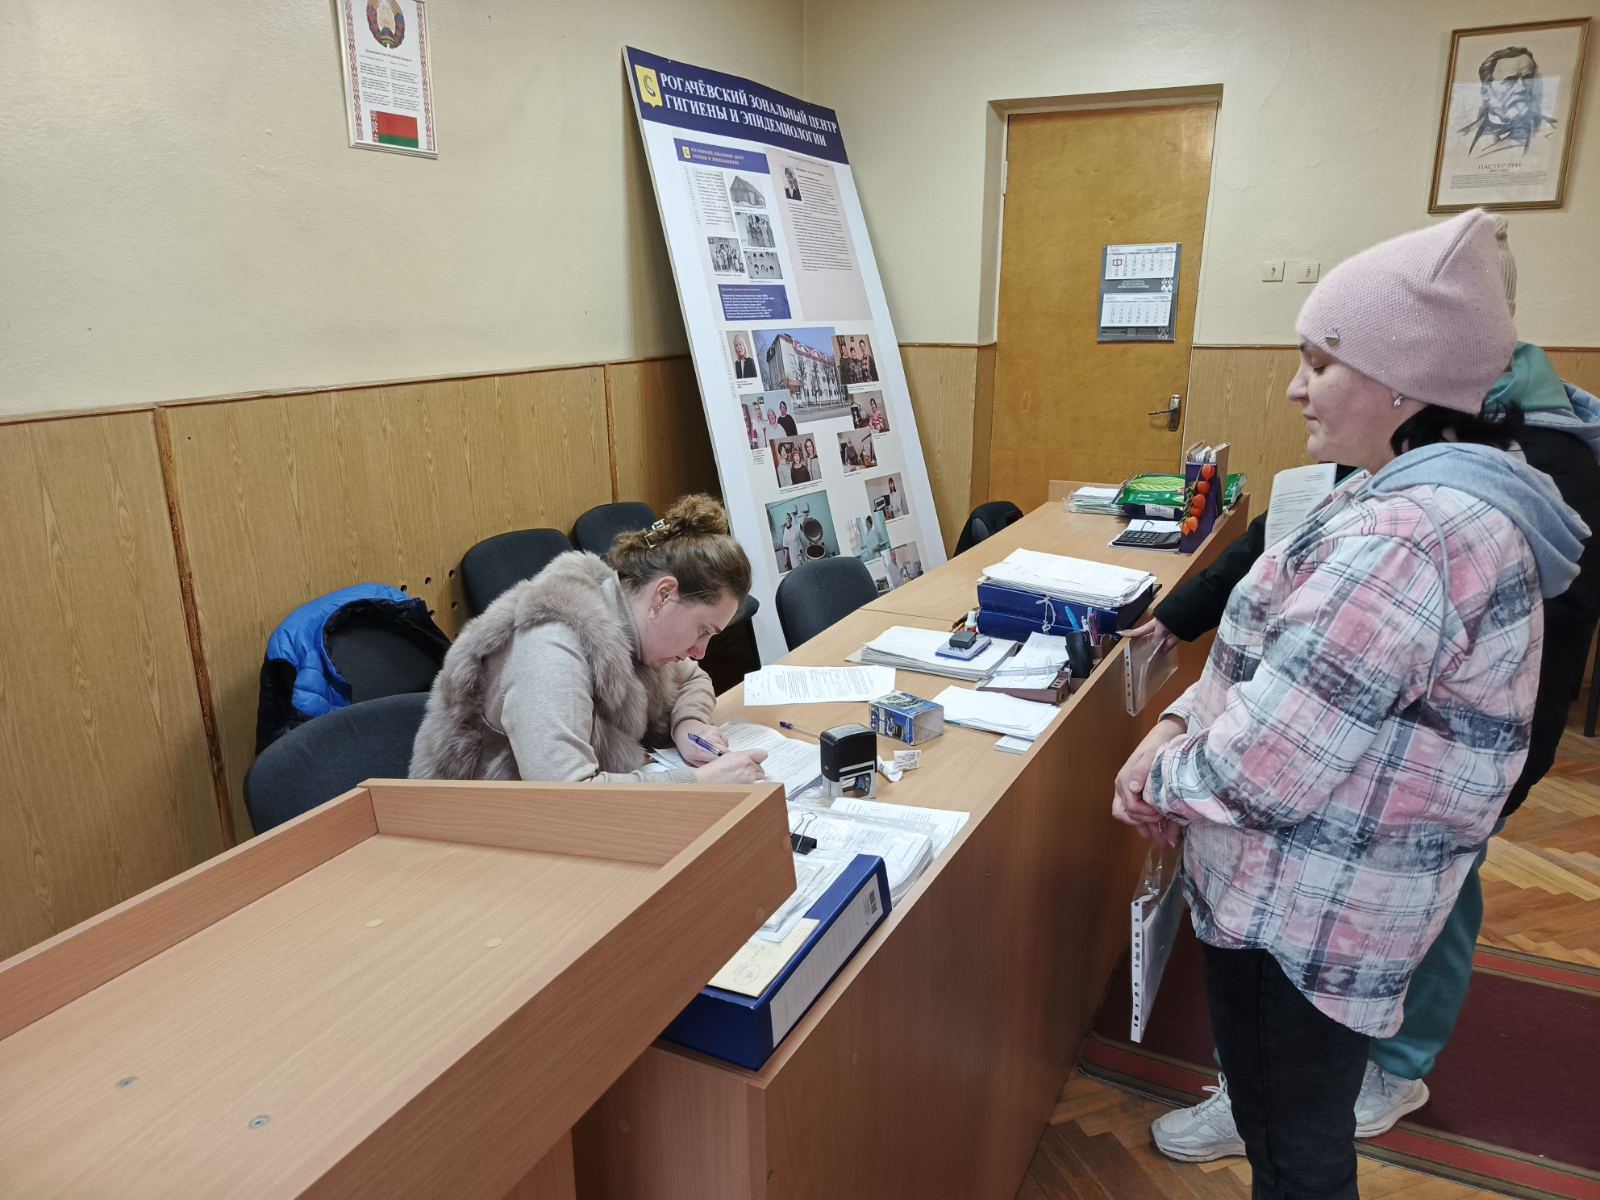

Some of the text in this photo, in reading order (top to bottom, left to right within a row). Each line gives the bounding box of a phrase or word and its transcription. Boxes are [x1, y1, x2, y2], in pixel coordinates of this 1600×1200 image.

[660, 72, 838, 134] РОГАЧЁВСКИЙ ЗОНАЛЬНЫЙ ЦЕНТР
[664, 94, 827, 147] ГИГИЕНЫ И ЭПИДЕМИОЛОГИИ
